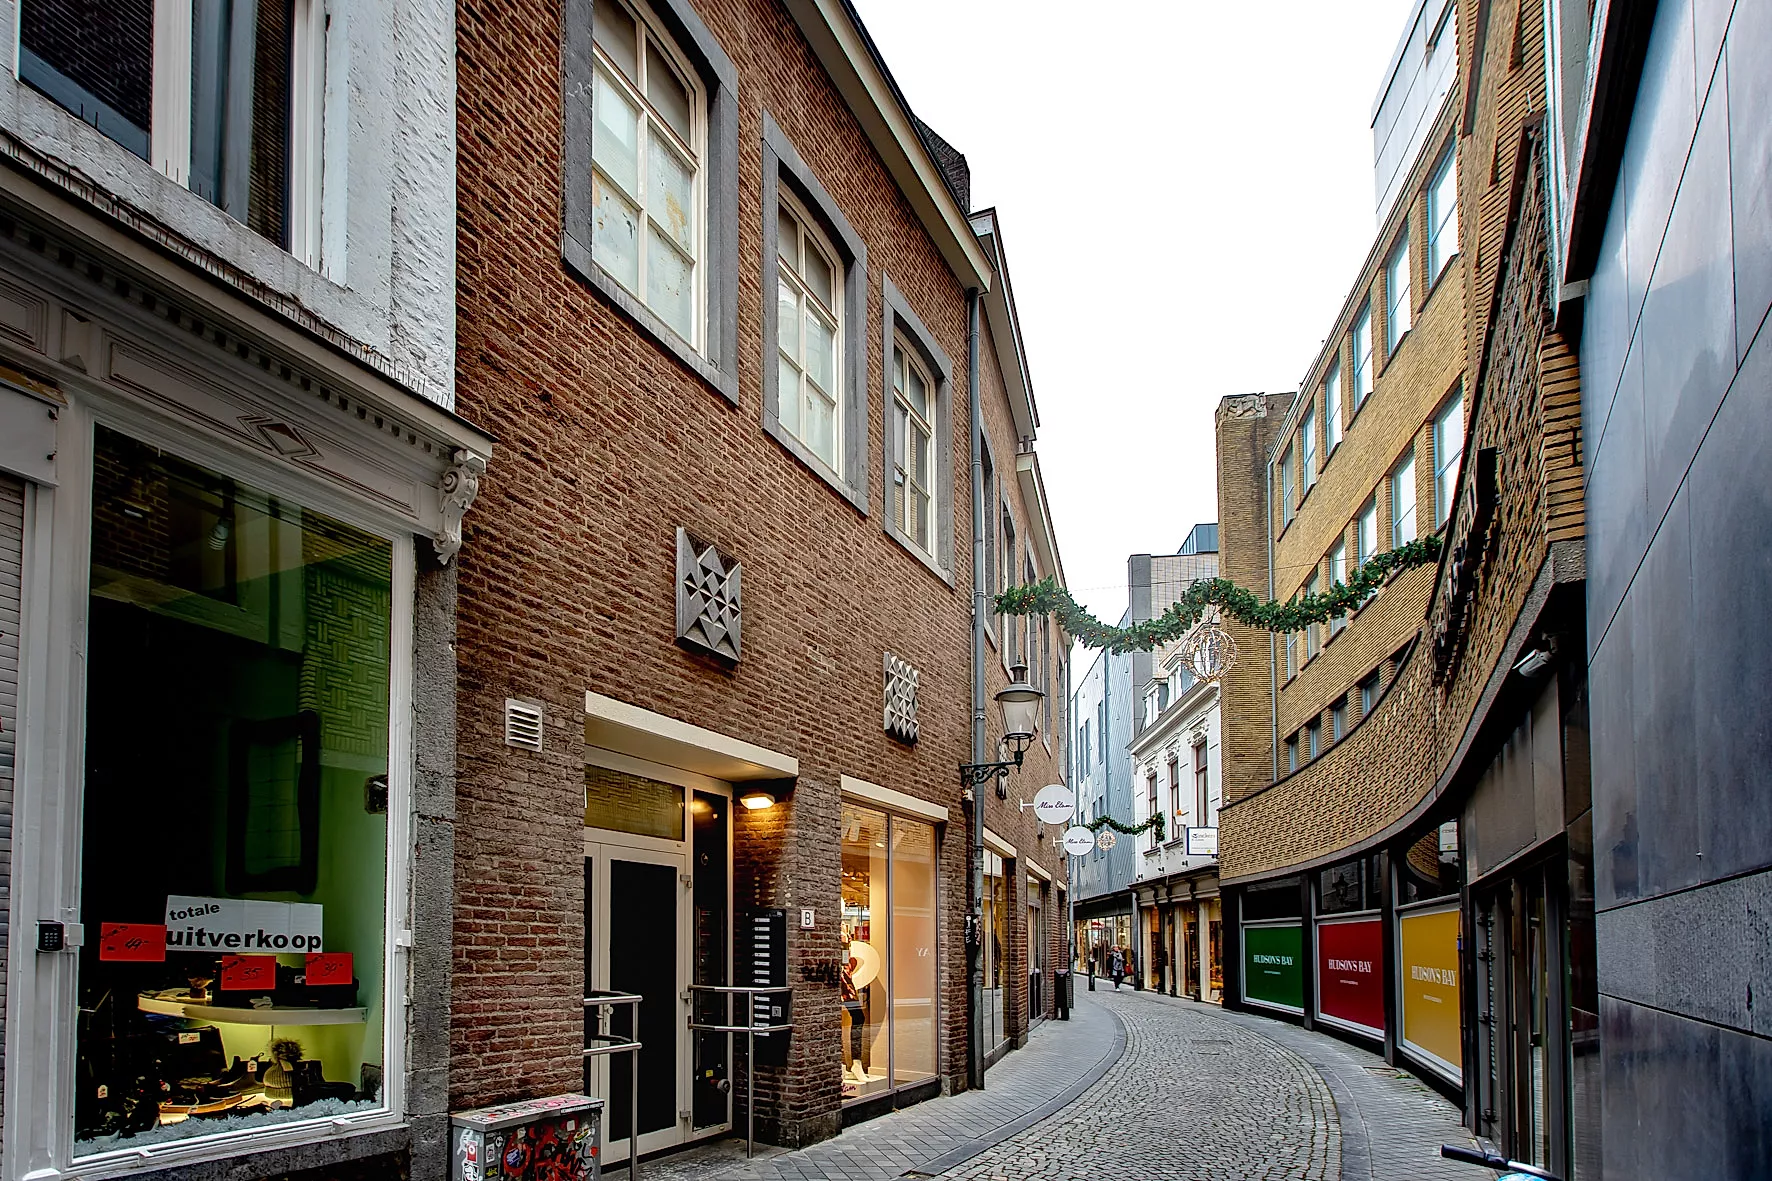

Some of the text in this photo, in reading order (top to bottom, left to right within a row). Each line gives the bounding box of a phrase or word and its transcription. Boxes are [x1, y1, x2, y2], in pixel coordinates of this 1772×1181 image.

[169, 903, 220, 921] totale
[804, 911, 811, 925] B
[165, 927, 322, 952] uitverkoop
[1281, 956, 1294, 966] BAY
[1358, 961, 1372, 973] BAY
[1441, 969, 1456, 987] BAY
